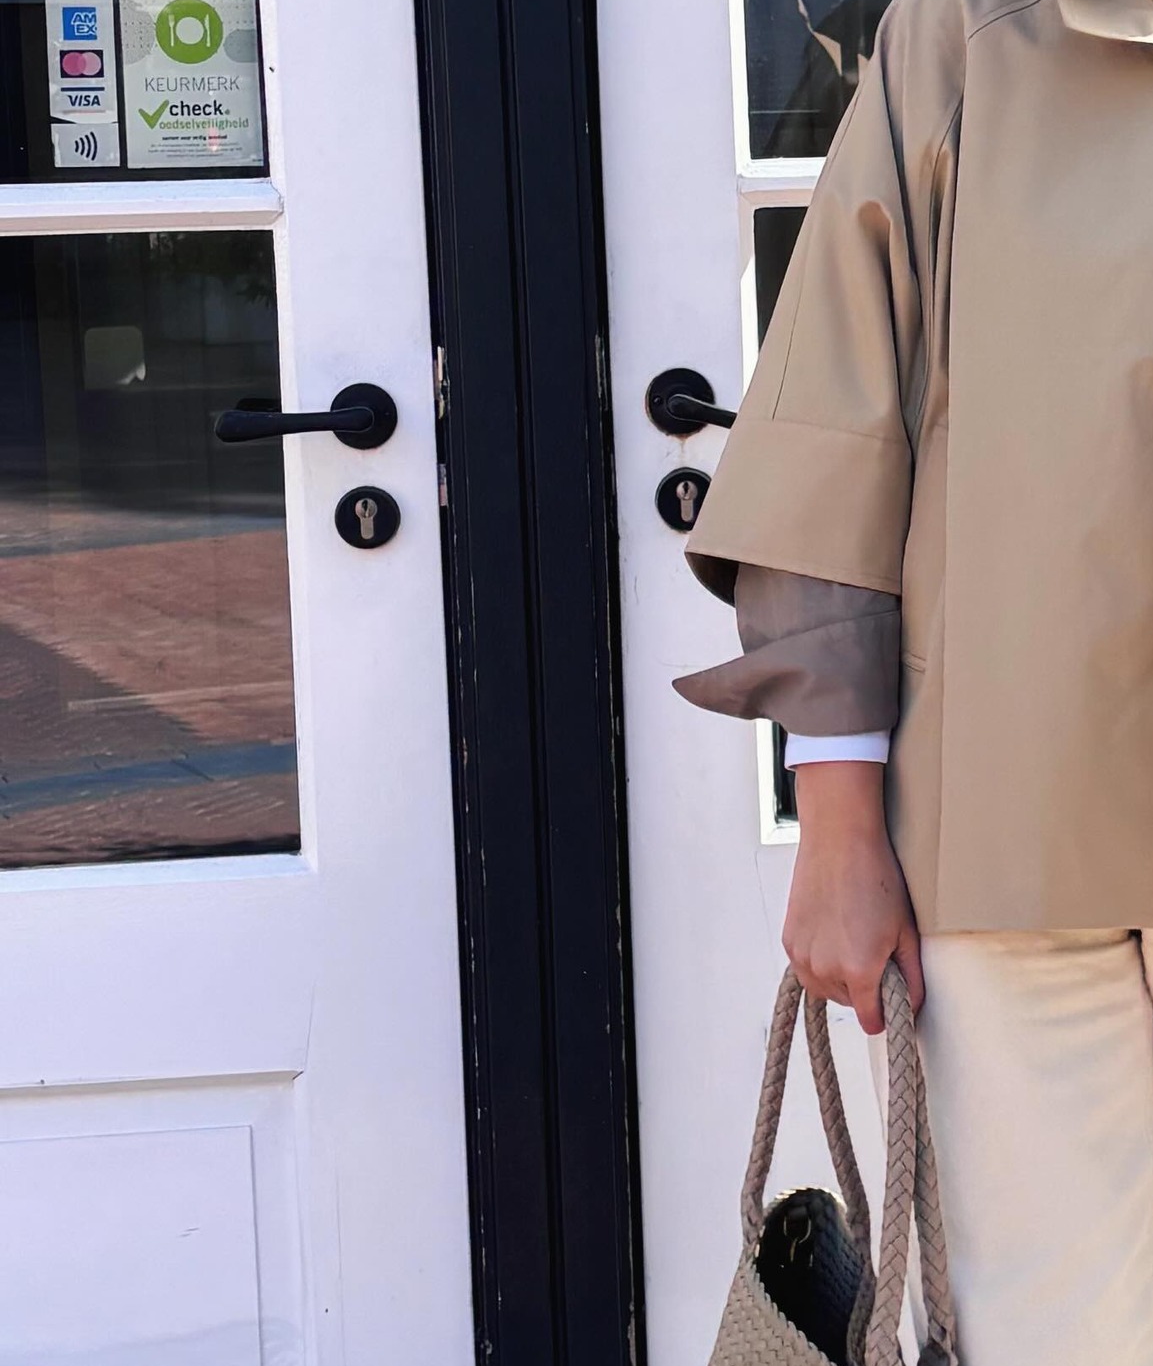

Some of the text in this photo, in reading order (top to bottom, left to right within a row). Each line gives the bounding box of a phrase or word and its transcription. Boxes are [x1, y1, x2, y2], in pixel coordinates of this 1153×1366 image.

[71, 12, 97, 24] AM
[144, 76, 241, 93] KEURMERK
[67, 94, 101, 107] VISA
